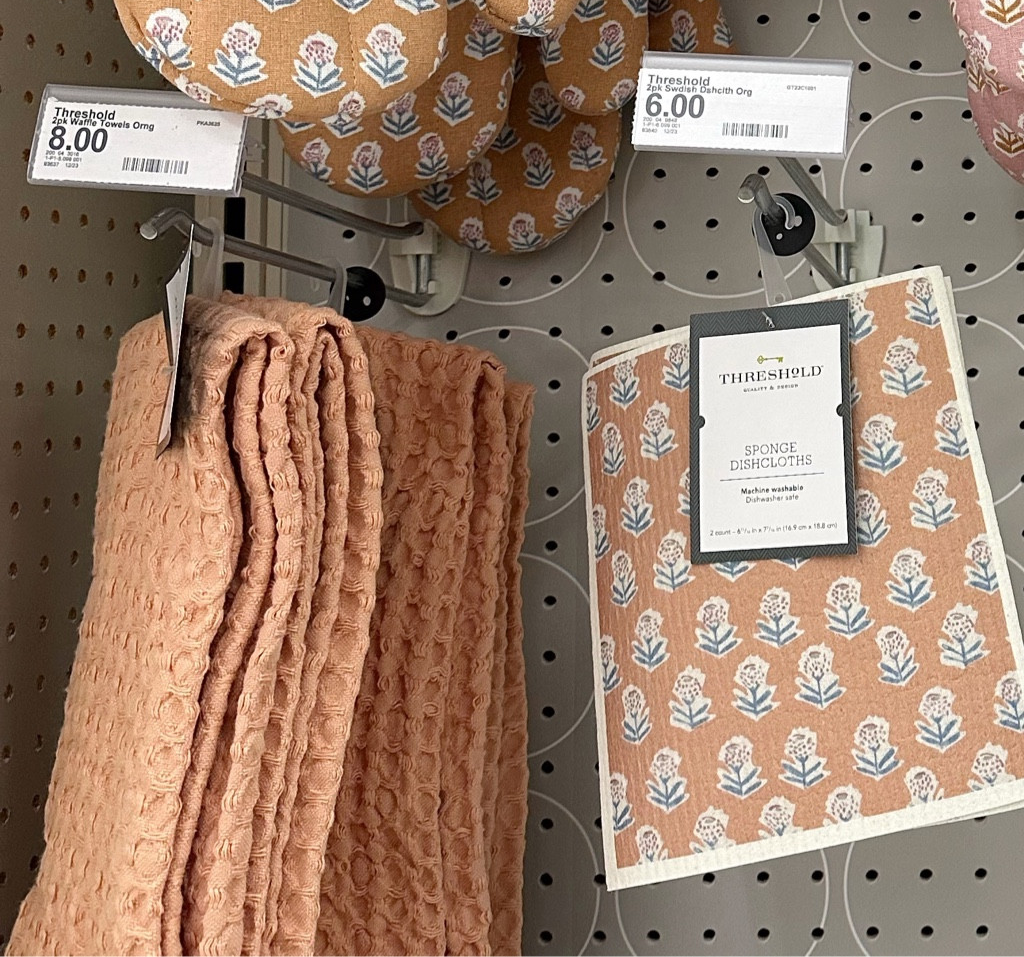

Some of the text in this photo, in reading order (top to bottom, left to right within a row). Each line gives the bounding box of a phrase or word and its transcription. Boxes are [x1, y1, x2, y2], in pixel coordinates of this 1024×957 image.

[648, 74, 710, 87] Threshold
[646, 84, 662, 93] 2pk
[665, 85, 697, 93] Swdish
[736, 87, 752, 97] Org
[646, 92, 705, 119] 6.00
[54, 107, 116, 120] Threshold
[52, 117, 67, 127] 2pk
[70, 118, 97, 127] Waffle
[100, 120, 130, 129] Towels
[49, 125, 108, 153] 8.00
[719, 366, 821, 384] THRESHOLD
[745, 442, 797, 456] SPONGE
[730, 454, 812, 471] DISHCLOTHS
[746, 495, 783, 503] Dishwasher
